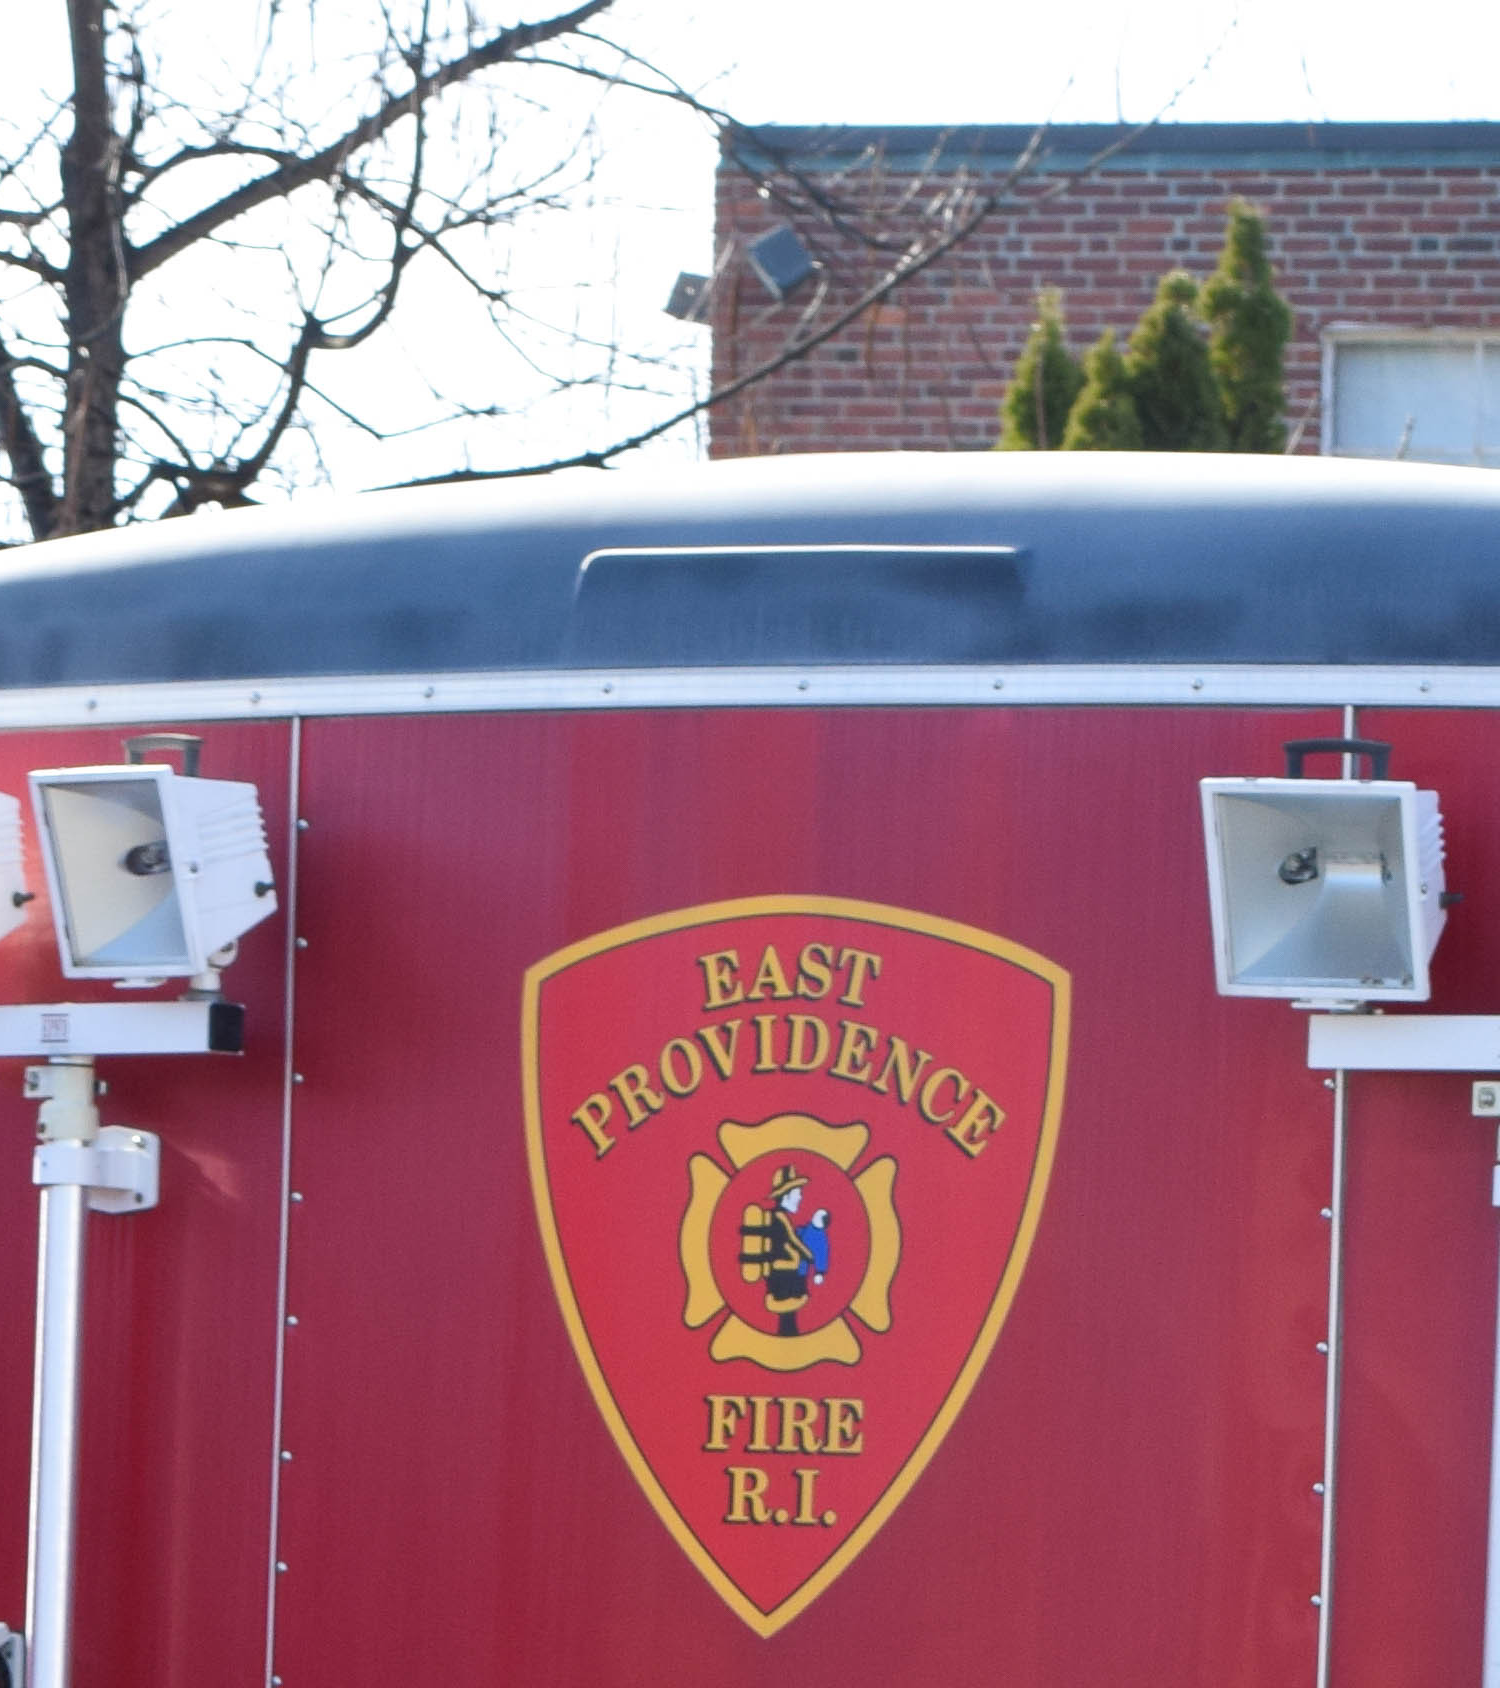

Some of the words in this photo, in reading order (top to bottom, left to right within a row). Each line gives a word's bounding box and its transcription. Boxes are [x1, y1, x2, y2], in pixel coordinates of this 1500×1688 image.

[699, 943, 882, 1010] EAST
[570, 1014, 1007, 1159] PROVIDENCE
[703, 1395, 864, 1455] FIRE
[724, 1466, 837, 1526] R.I.
